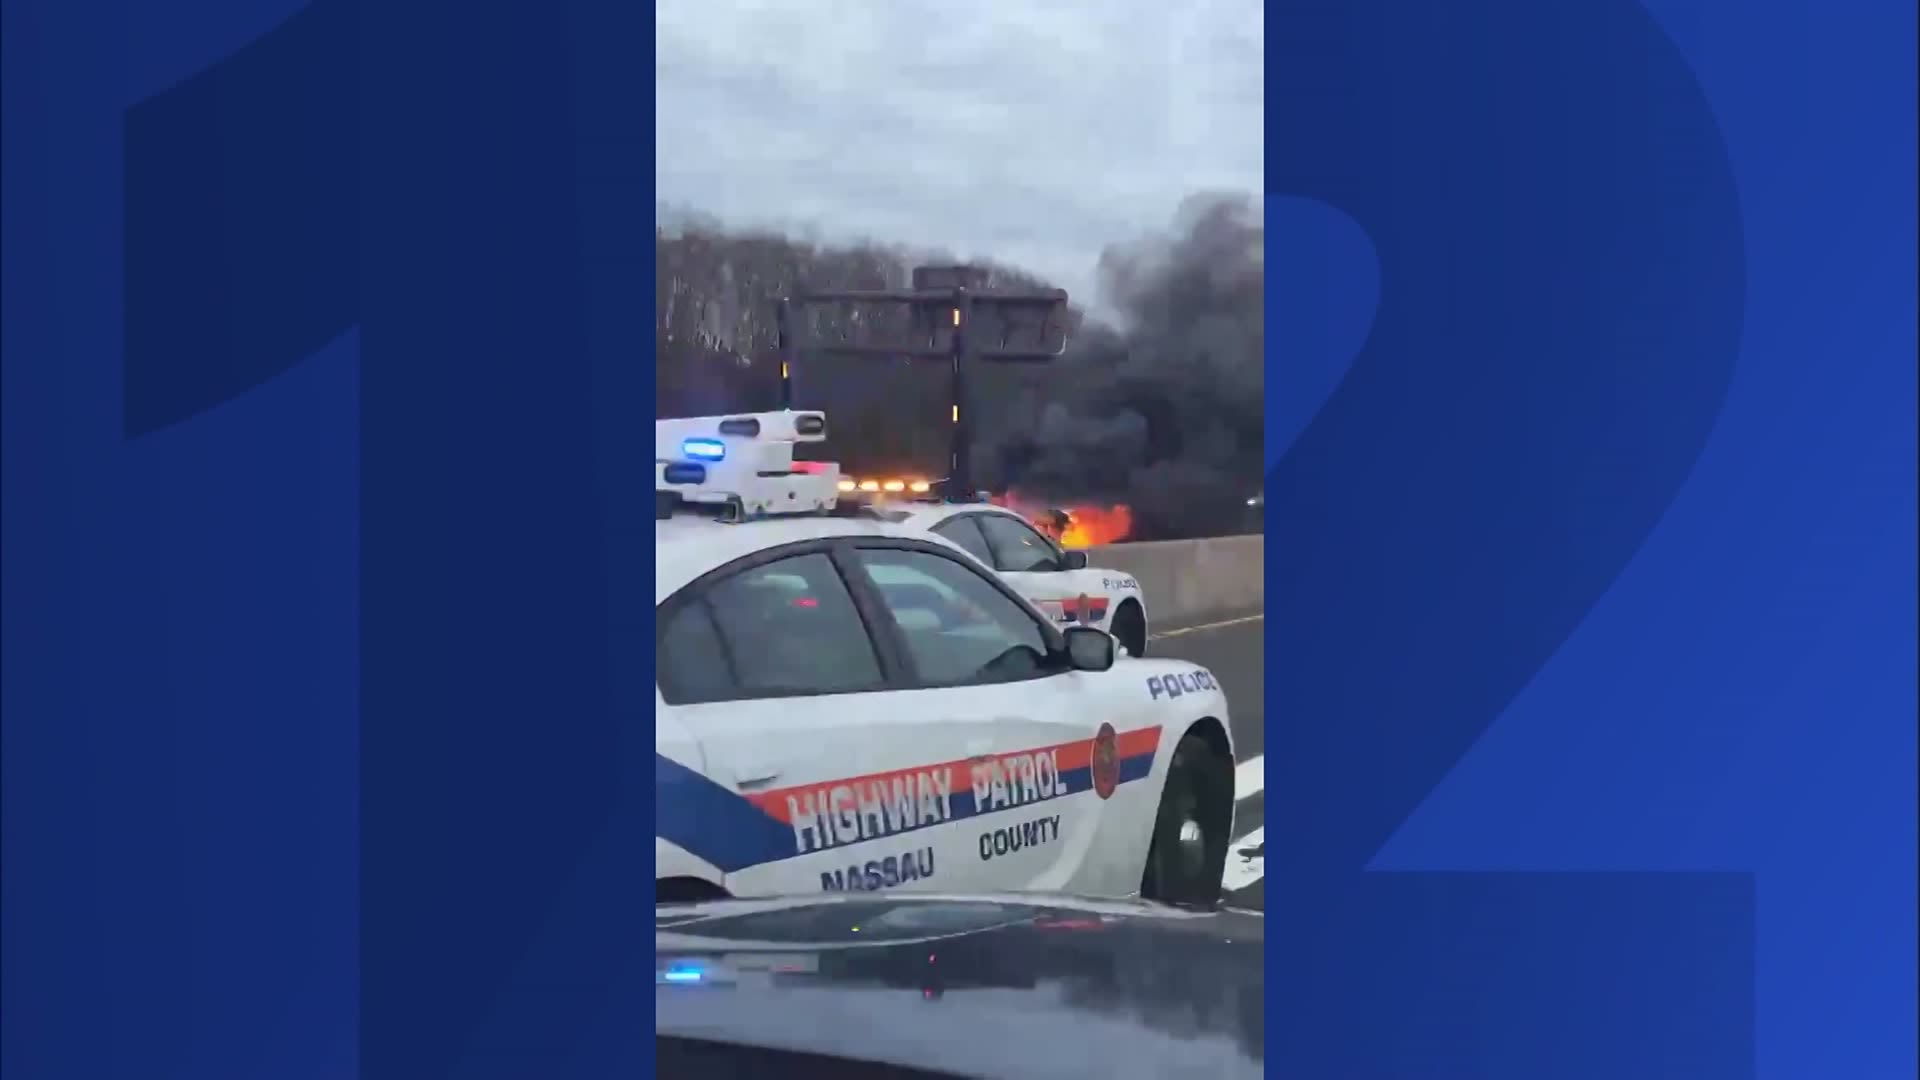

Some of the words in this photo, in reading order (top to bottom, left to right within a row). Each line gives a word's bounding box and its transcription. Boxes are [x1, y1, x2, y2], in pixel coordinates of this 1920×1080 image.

[786, 767, 953, 853] HIGHWAY
[971, 749, 1066, 813] PATROL
[821, 847, 934, 891] NASSAU
[980, 815, 1060, 860] COUNTY
